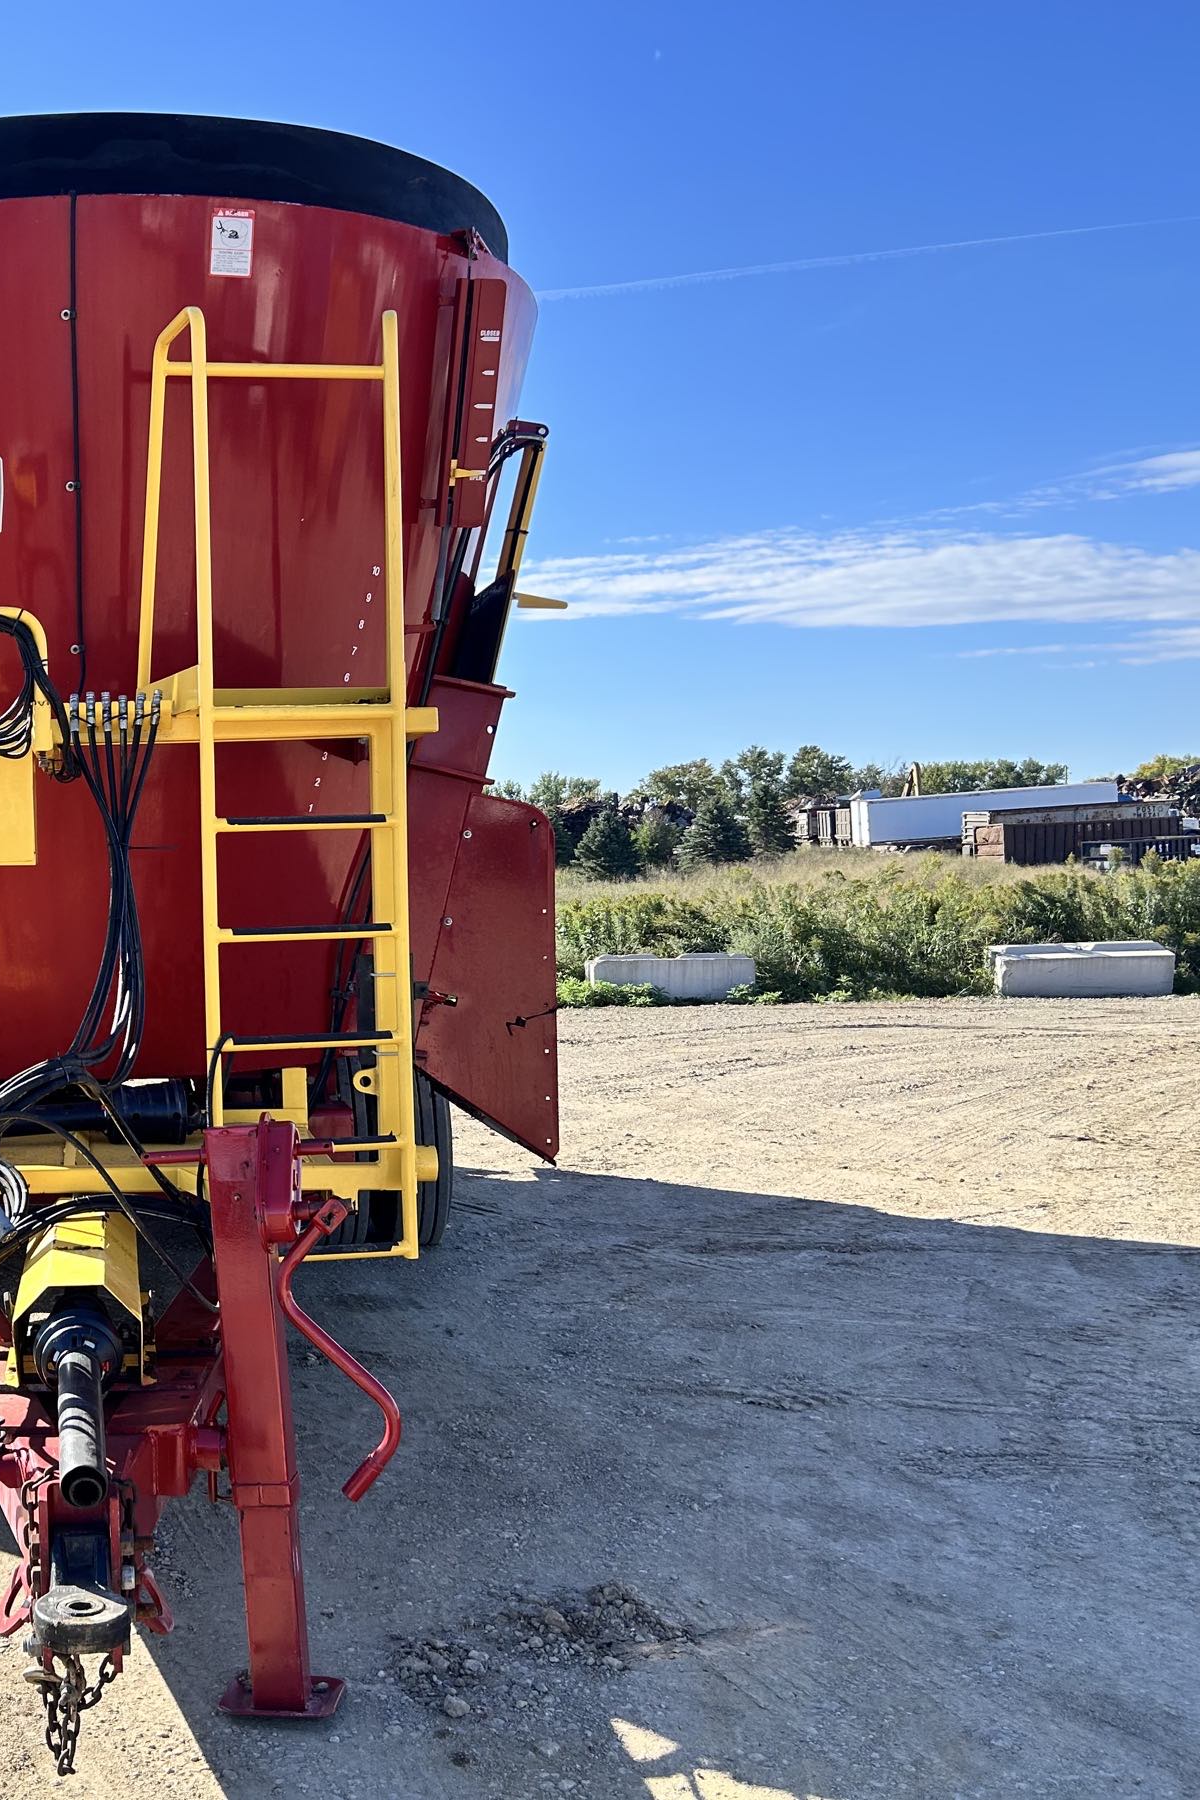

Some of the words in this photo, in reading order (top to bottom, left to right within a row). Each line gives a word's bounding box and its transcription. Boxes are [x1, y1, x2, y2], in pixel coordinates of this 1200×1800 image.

[372, 566, 380, 576] 10
[365, 593, 372, 602] 9
[358, 619, 364, 629] 8
[352, 646, 357, 656] 7
[344, 672, 350, 682] 6
[321, 751, 328, 761] 3
[314, 777, 321, 787] 2
[308, 804, 313, 813] 1
